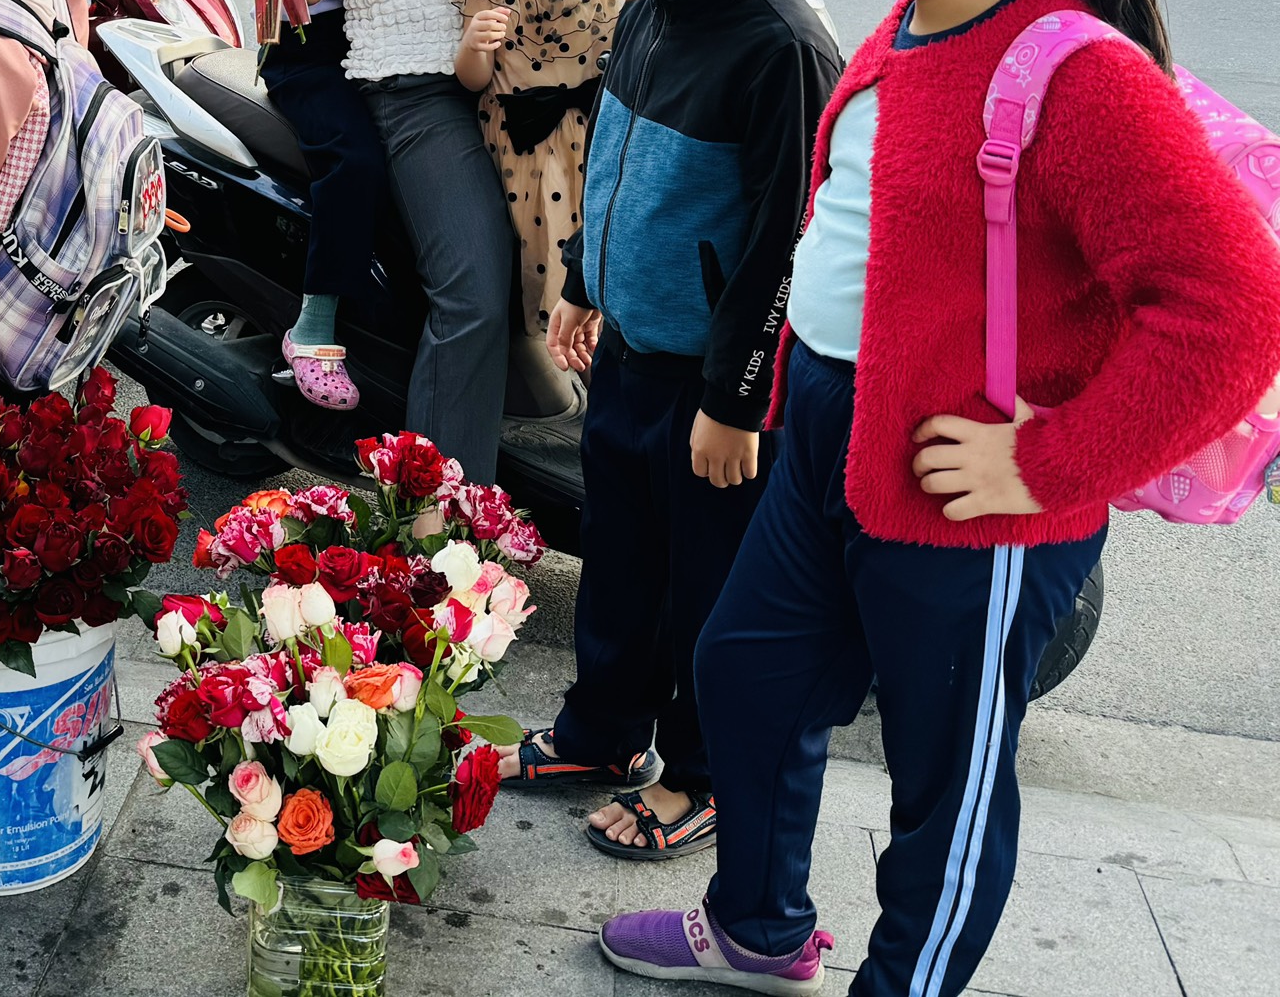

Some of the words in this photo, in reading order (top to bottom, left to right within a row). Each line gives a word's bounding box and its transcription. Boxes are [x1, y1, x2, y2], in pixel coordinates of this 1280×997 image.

[162, 154, 219, 190] EAD
[763, 309, 781, 334] IVY
[773, 276, 792, 309] KIDS
[744, 349, 765, 381] KIDS
[6, 821, 49, 836] Emulsion
[686, 908, 710, 953] OCS
